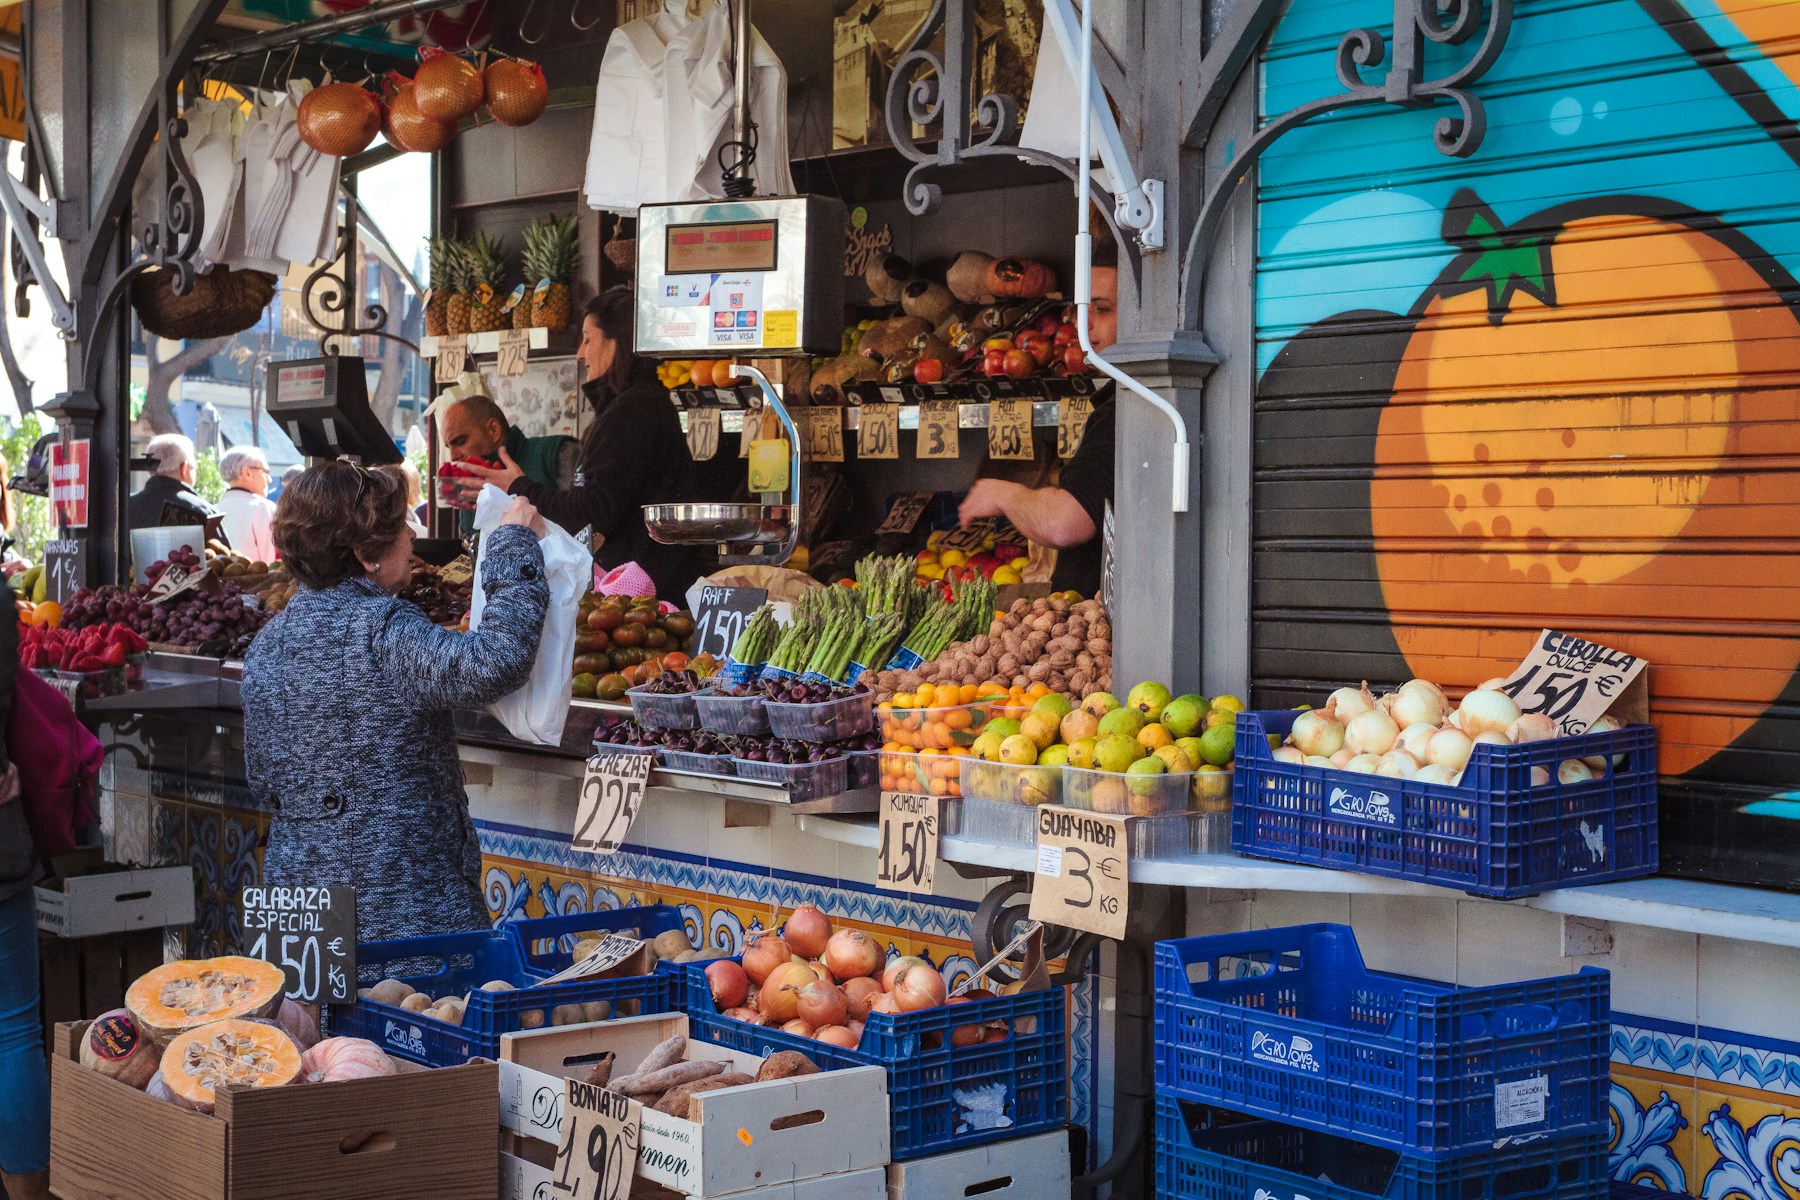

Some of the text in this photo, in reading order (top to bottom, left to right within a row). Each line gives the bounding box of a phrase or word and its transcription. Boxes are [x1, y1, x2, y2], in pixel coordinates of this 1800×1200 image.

[740, 332, 754, 340] VISA
[928, 422, 945, 454] 3
[52, 557, 62, 604] 1
[702, 586, 735, 606] RAFF
[1542, 630, 1637, 673] CEBOLLA
[1546, 653, 1598, 674] DULCE
[1594, 674, 1624, 698] €
[1559, 715, 1587, 736] KG
[588, 754, 648, 780] CEREZAS
[890, 794, 929, 815] KUMQUAT
[1040, 808, 1116, 848] GUAYABA
[878, 815, 937, 886] 1,50 €
[1064, 846, 1094, 908] 3
[1096, 857, 1122, 880] €
[242, 886, 332, 910] CALABAZA
[1100, 894, 1118, 915] KG
[244, 910, 325, 932] ESPECIAL
[326, 936, 347, 957] €
[1288, 1035, 1313, 1065] PONS
[569, 1080, 629, 1122] BONIATO
[1516, 1086, 1543, 1097] ALCACHOFA
[622, 1122, 638, 1150] €
